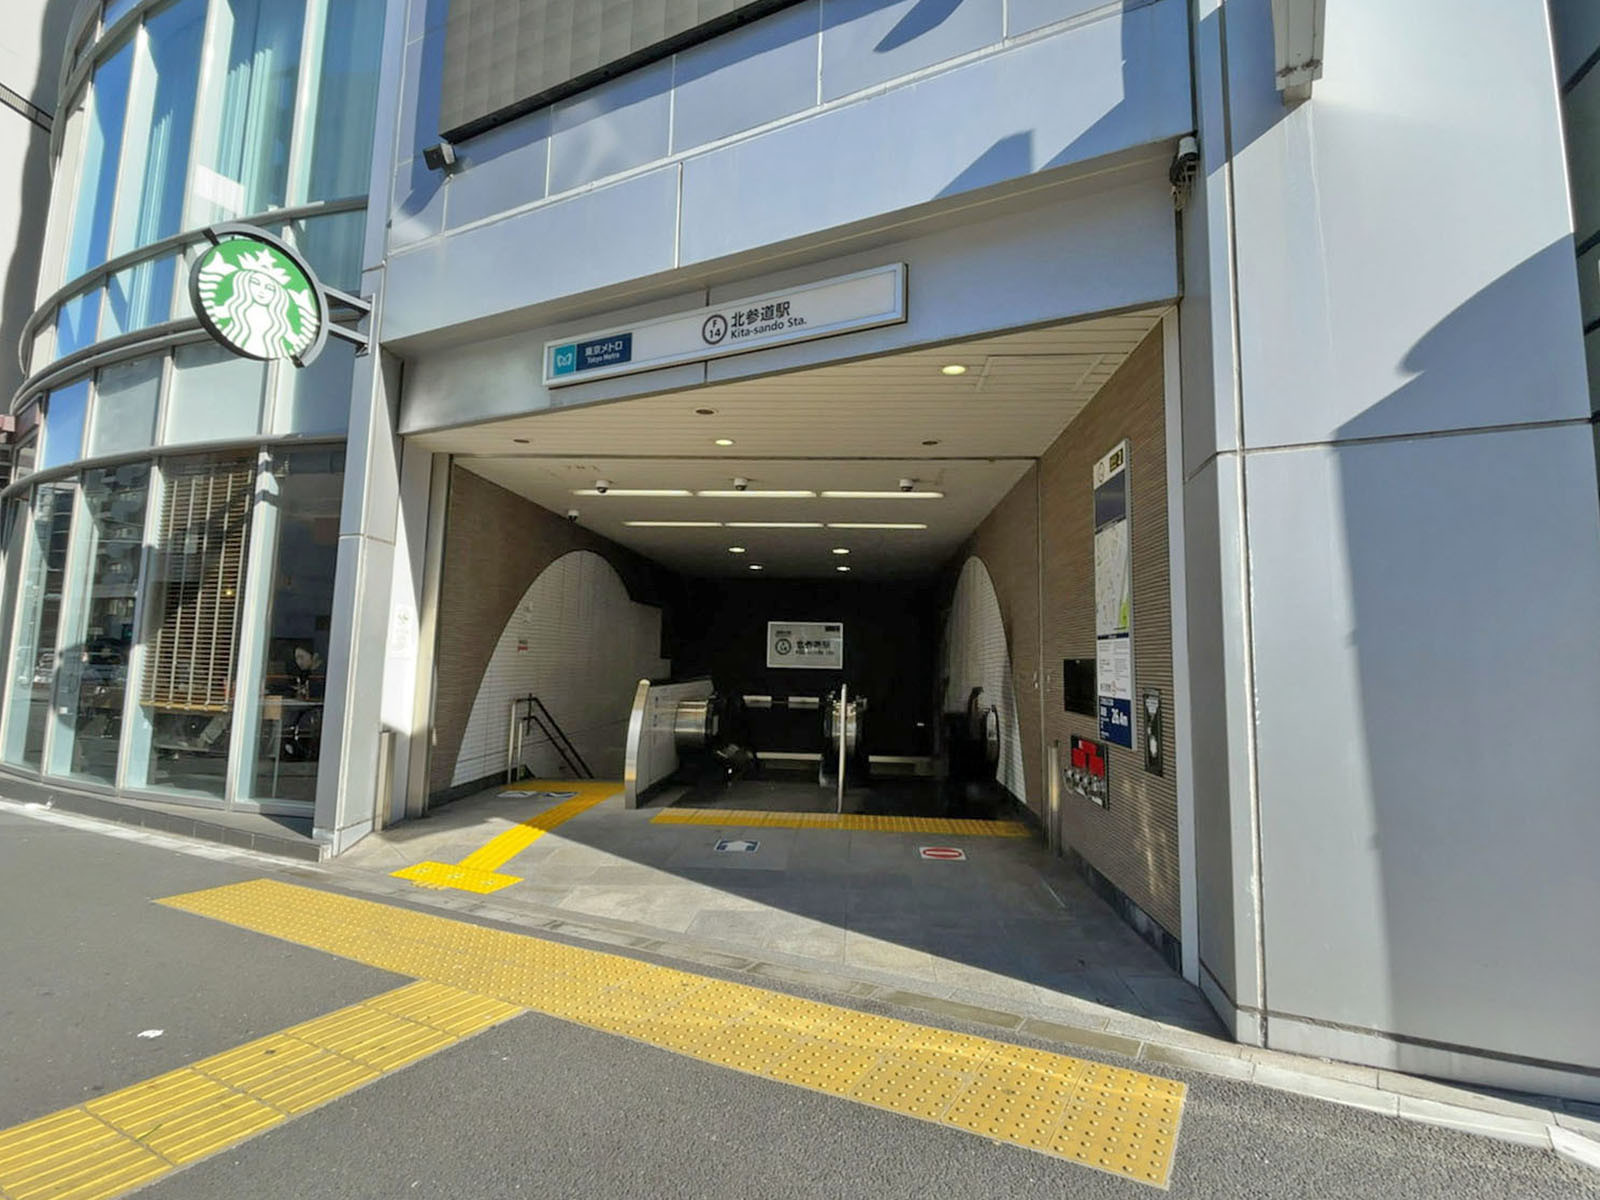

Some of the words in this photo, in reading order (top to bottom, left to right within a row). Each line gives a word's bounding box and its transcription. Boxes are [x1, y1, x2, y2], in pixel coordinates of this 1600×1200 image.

[730, 301, 790, 328] 北参道駅
[712, 319, 718, 328] F
[730, 321, 784, 339] Kita-sando
[787, 317, 807, 328] Sta.
[709, 328, 721, 339] 14
[585, 341, 622, 356] 東京メトロ
